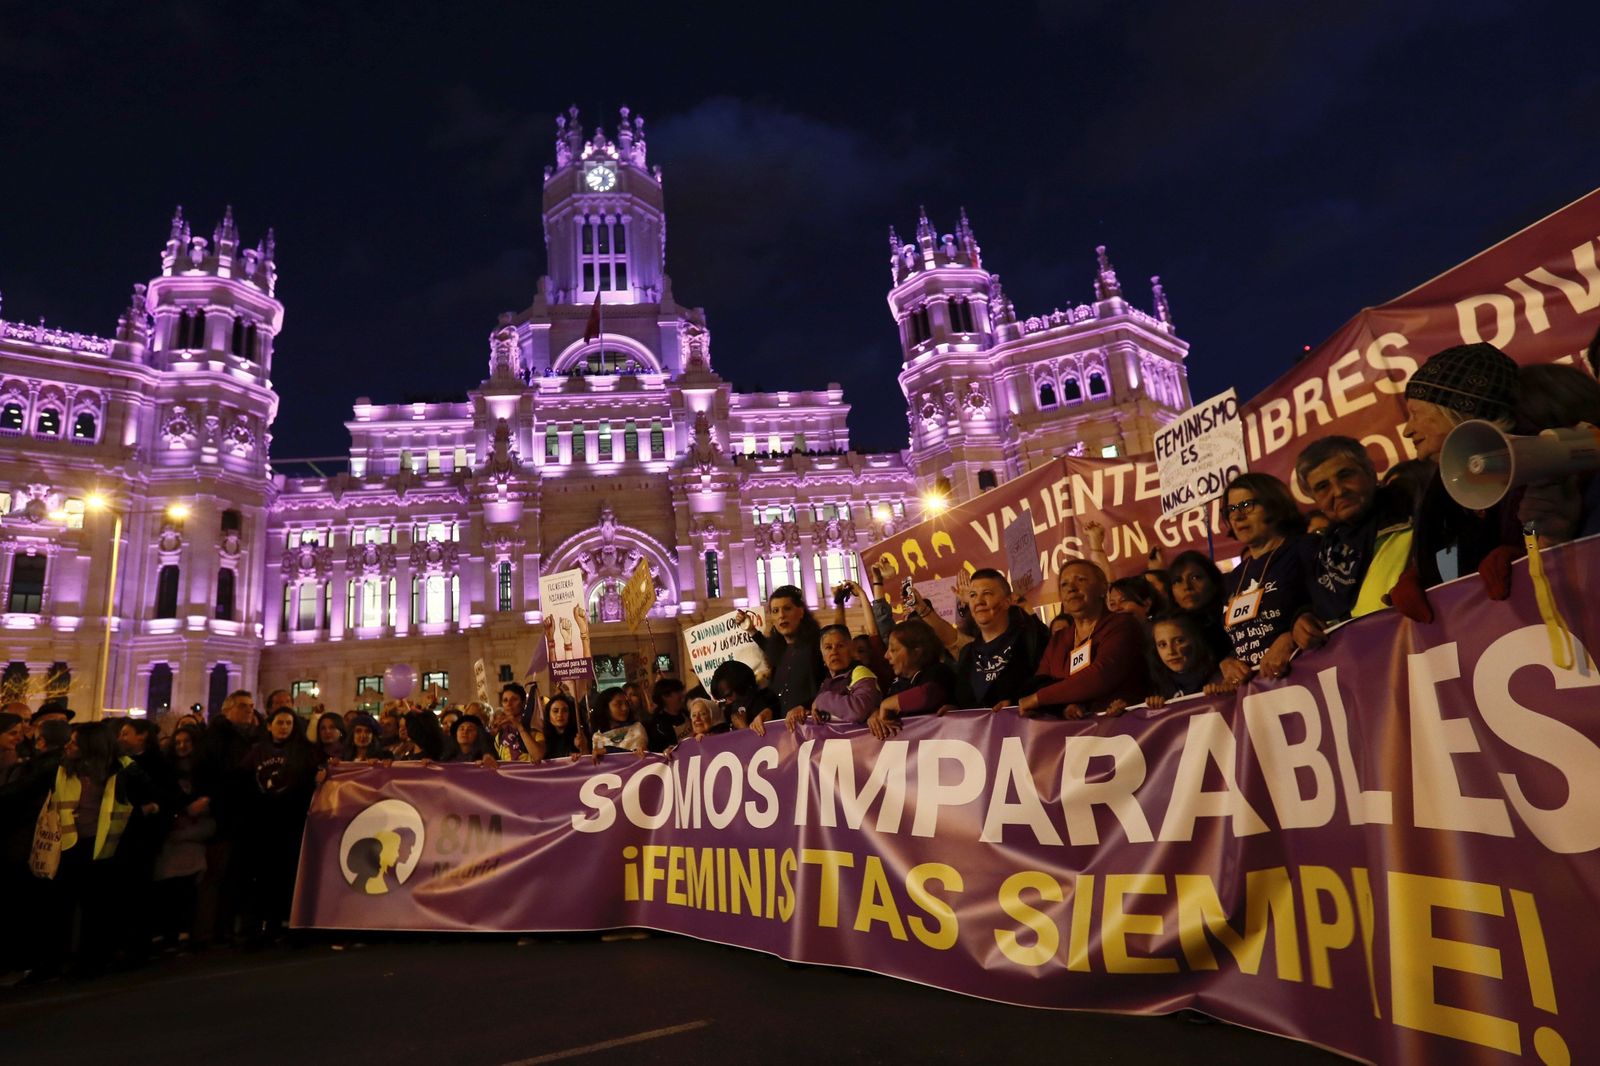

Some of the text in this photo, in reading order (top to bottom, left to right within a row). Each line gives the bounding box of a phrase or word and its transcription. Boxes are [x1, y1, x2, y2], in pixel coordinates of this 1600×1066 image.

[970, 463, 1161, 553] VALIENTE
[1245, 332, 1419, 462] IBRES
[1455, 236, 1600, 350] DIV
[1155, 397, 1238, 461] FEMINISMO
[1180, 444, 1199, 465] ES
[1162, 485, 1195, 512] NUNCA
[1197, 465, 1241, 497] ODIO
[1153, 499, 1221, 548] GRI
[1233, 605, 1249, 618] DR
[729, 632, 754, 647] MUJERE
[1246, 623, 1274, 639] brujas
[1250, 639, 1260, 650] no
[1073, 653, 1084, 666] DR
[571, 623, 1600, 854] SOMOS IMPARABLES
[434, 814, 503, 856] 8M
